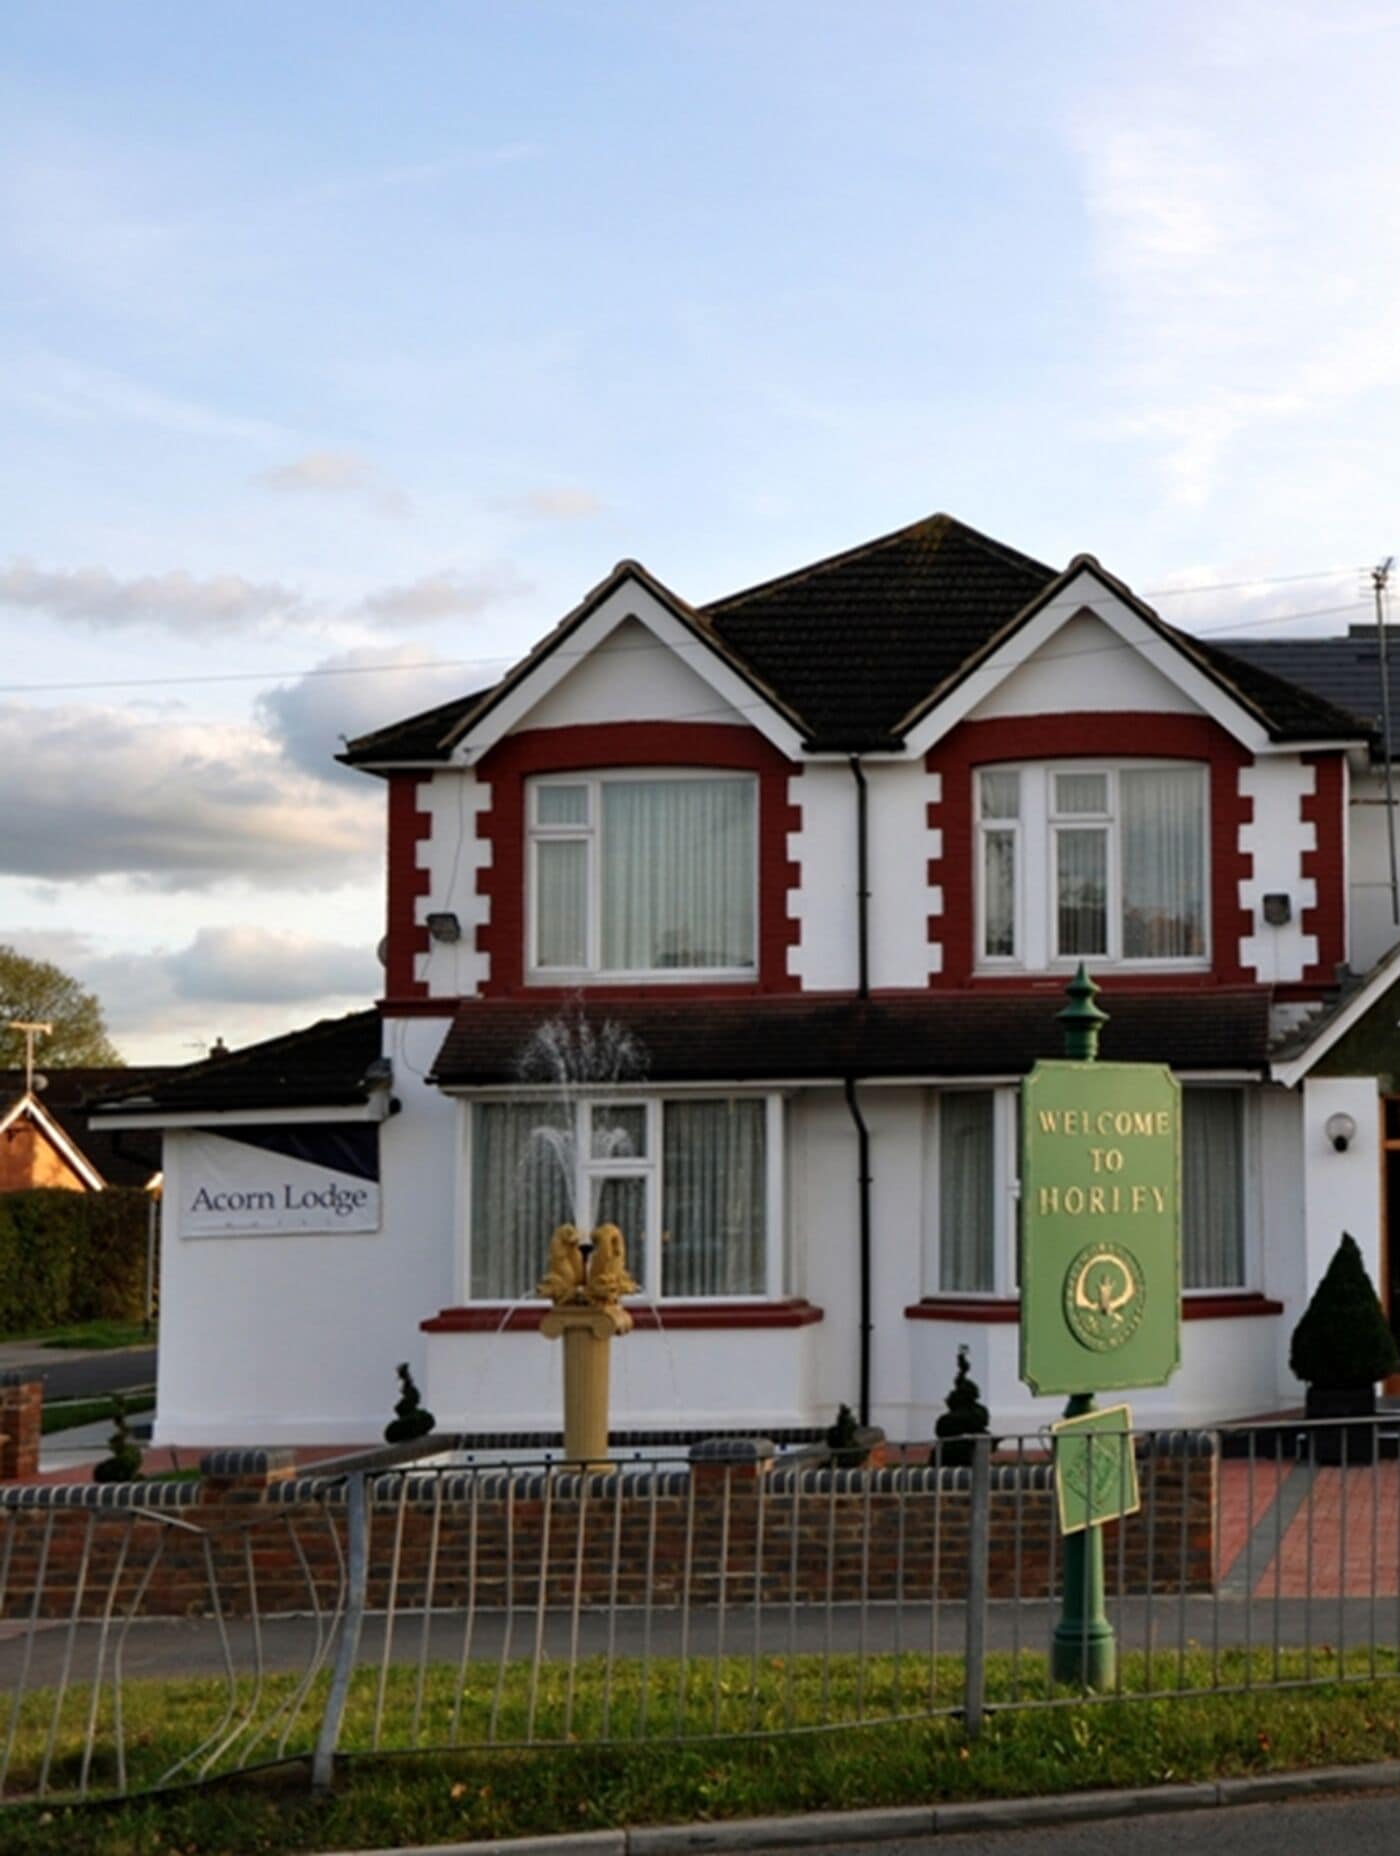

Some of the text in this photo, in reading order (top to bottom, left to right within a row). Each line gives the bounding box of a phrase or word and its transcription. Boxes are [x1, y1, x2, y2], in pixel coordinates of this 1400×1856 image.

[1039, 1111, 1169, 1135] WELCOME
[1091, 1148, 1123, 1173] TO
[191, 1184, 367, 1216] Acorn Lodge
[1040, 1186, 1168, 1214] HORLEY
